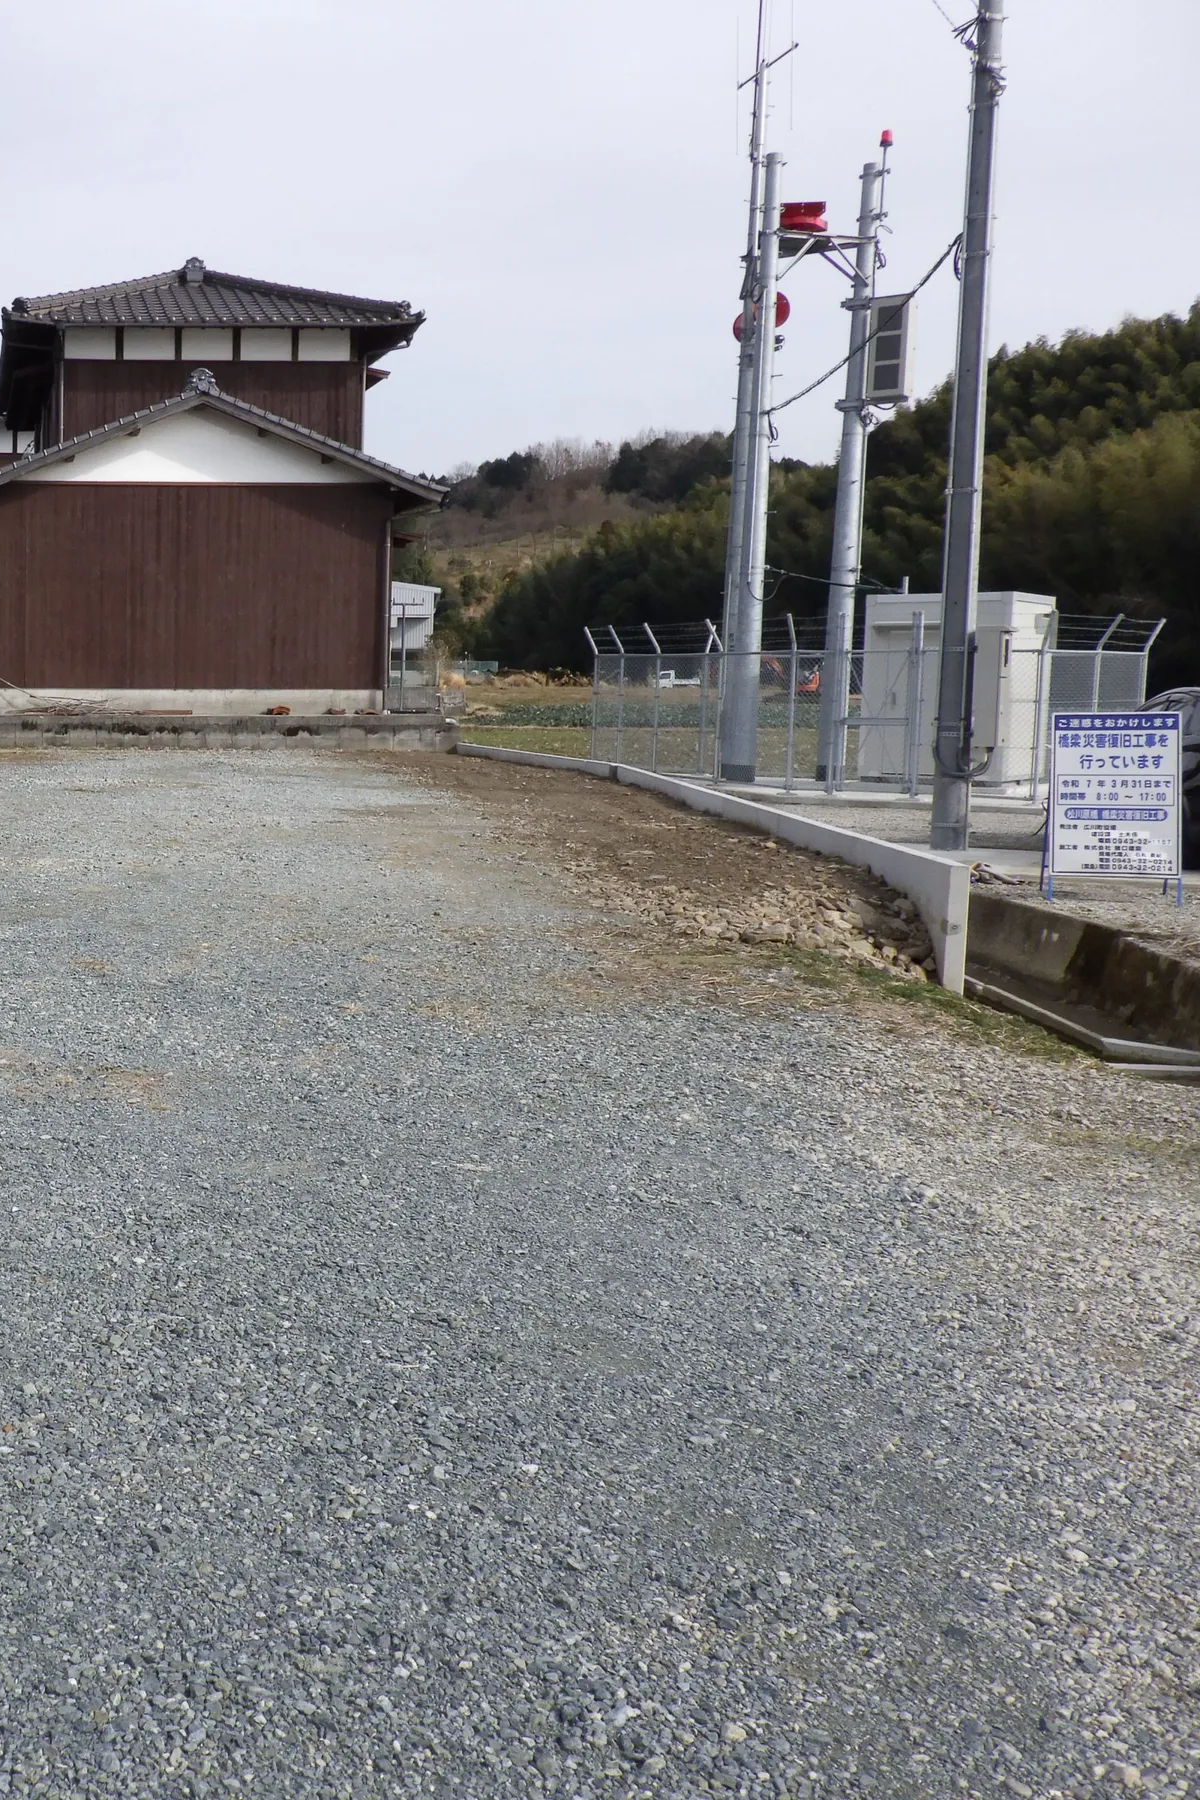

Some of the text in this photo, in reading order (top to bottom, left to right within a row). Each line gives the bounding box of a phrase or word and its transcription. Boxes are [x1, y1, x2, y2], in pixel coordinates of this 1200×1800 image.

[1058, 718, 1176, 728] ご迷惑をおかけします
[1058, 733, 1169, 748] 橋梁災害復旧工事を
[1079, 754, 1164, 769] 行っています
